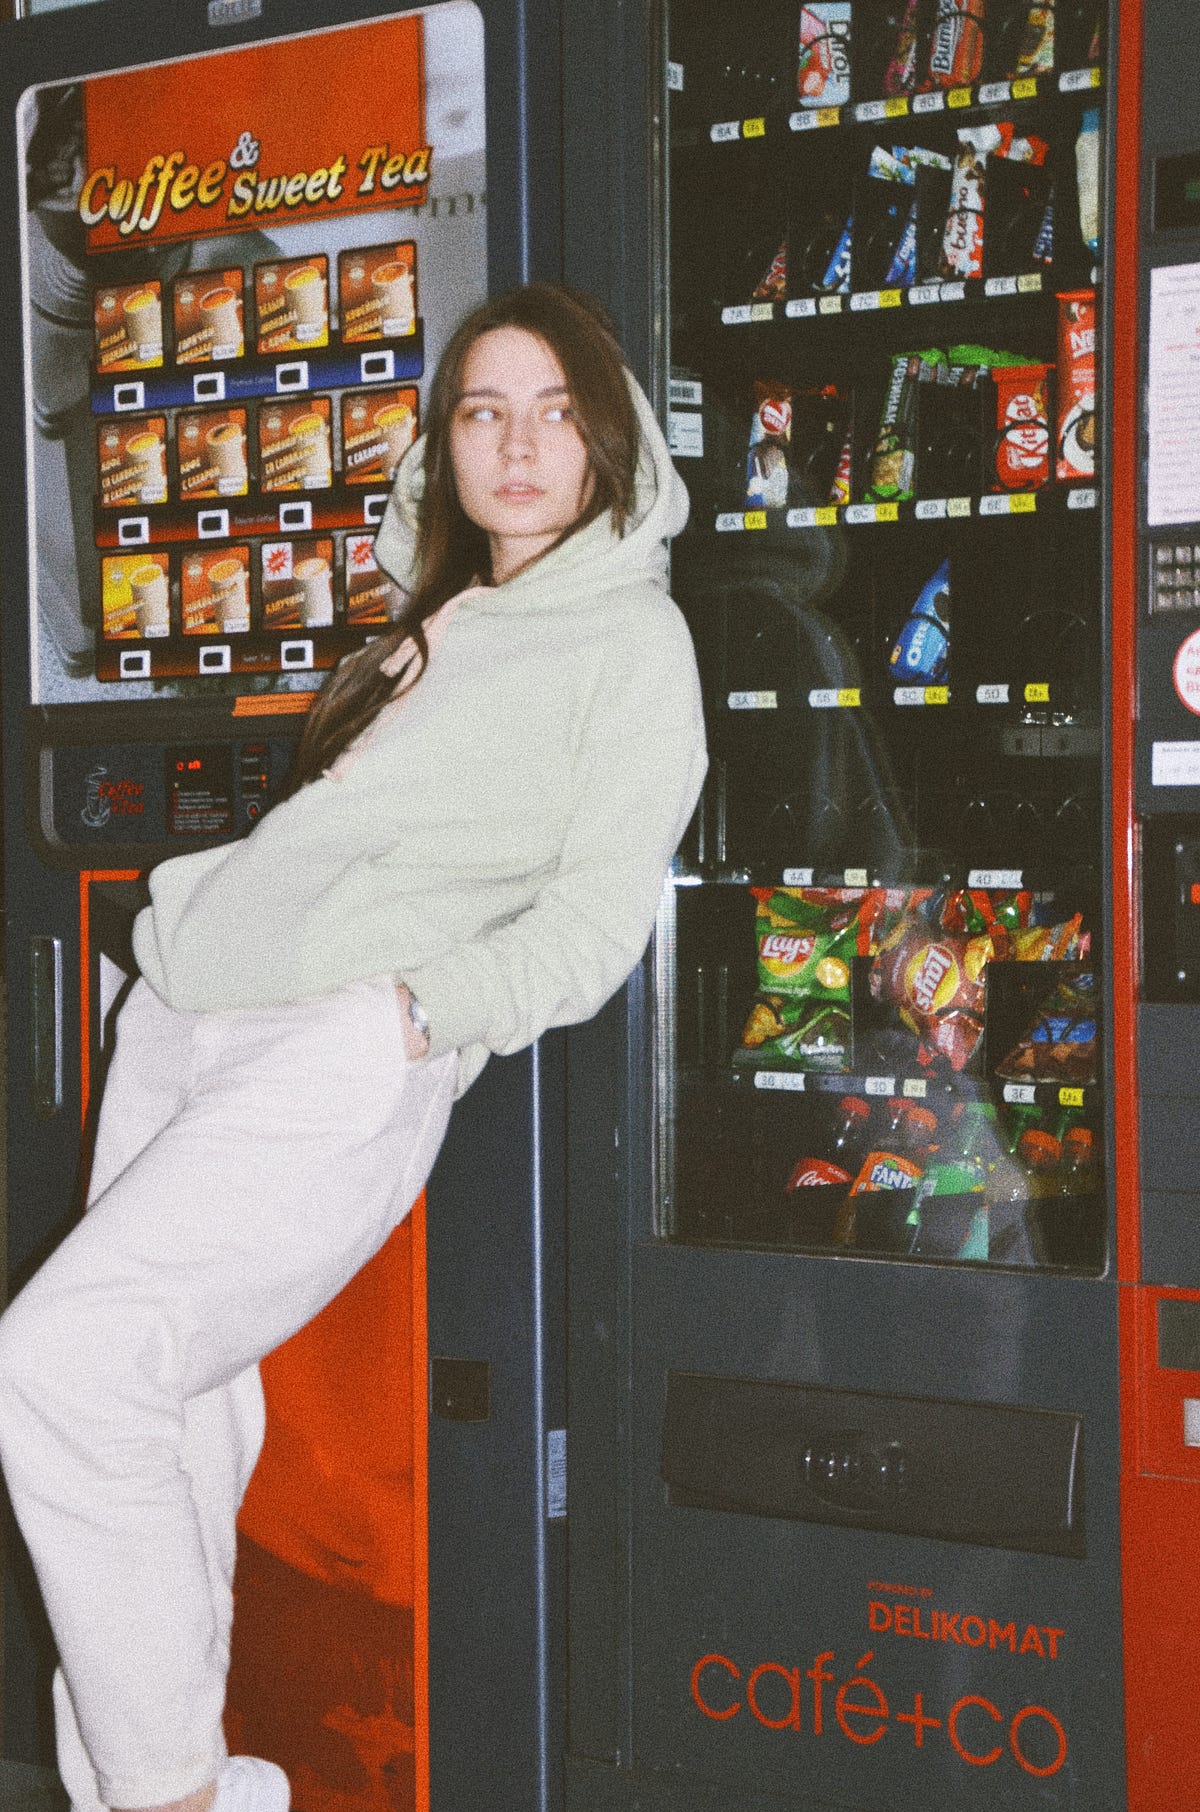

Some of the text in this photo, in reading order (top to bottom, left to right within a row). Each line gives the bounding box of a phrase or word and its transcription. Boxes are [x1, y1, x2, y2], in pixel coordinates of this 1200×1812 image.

[79, 131, 433, 236] Coffee & Sweet Tea
[950, 186, 969, 250] bueno
[869, 1163, 912, 1190] FANT
[868, 1601, 1065, 1659] DELIKOMAT
[691, 1651, 1068, 1777] café+co
